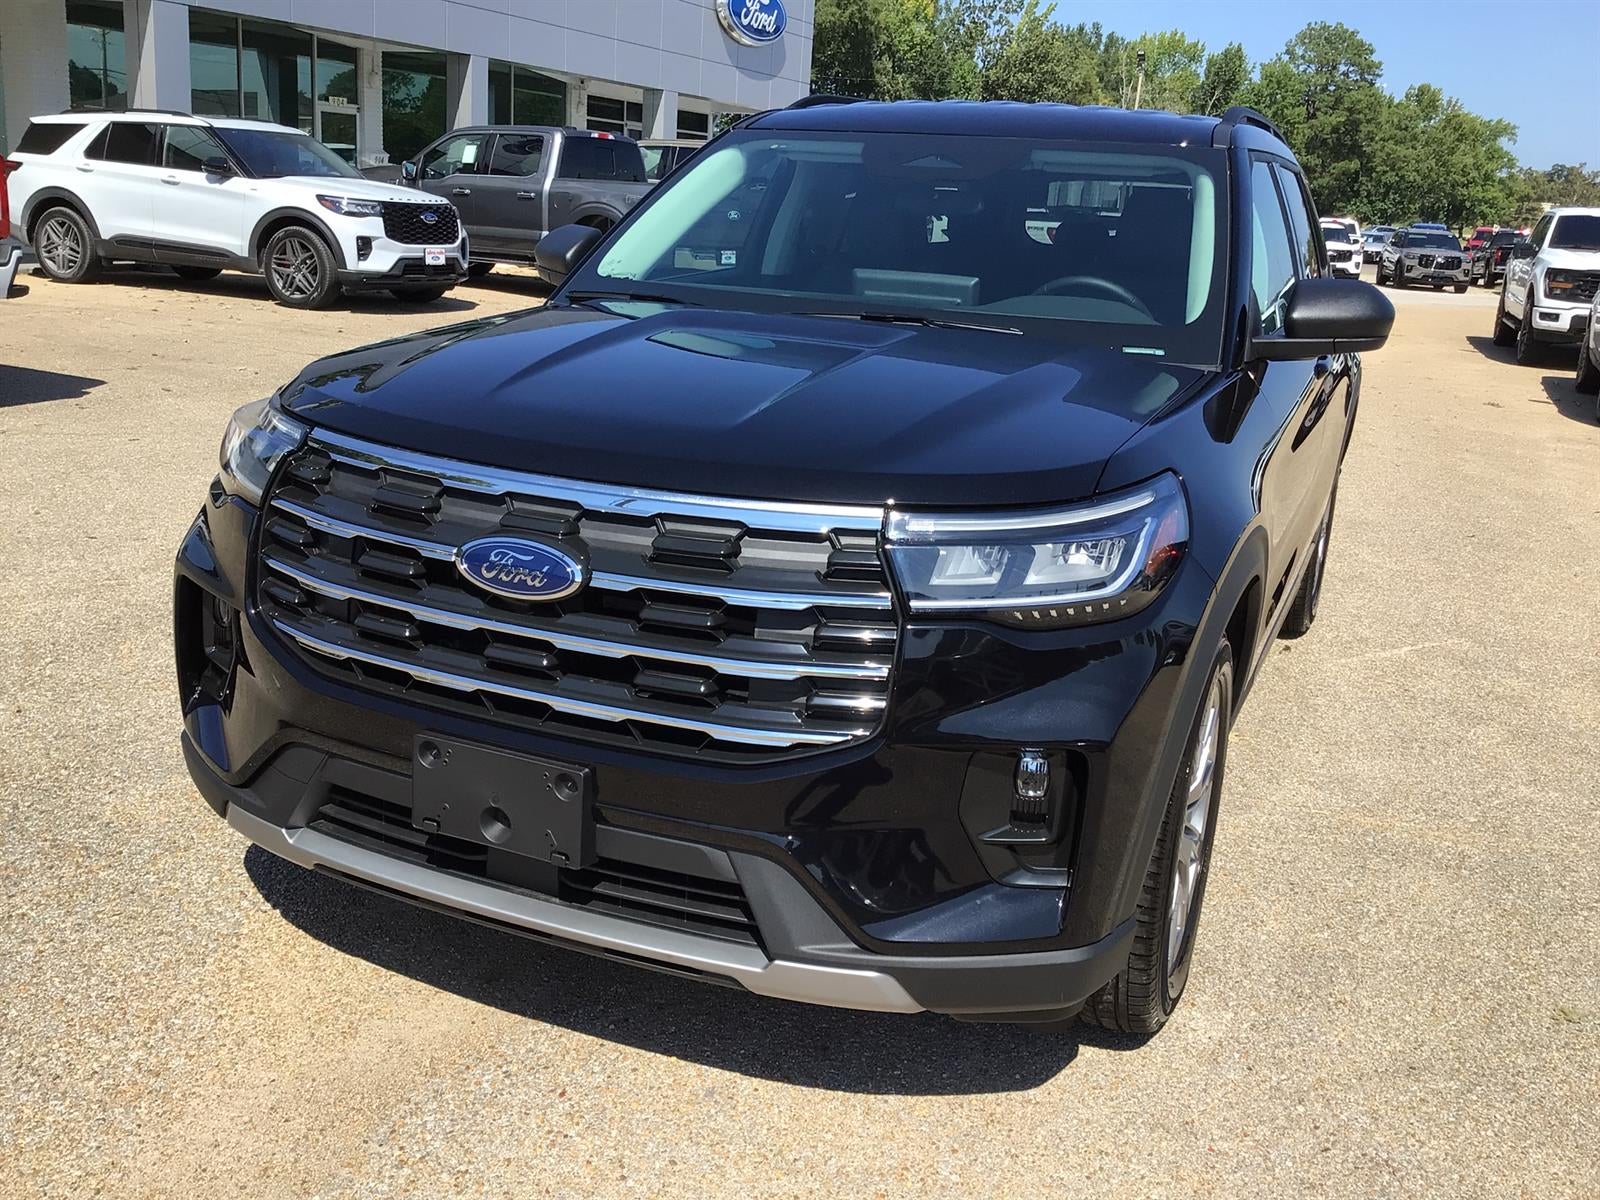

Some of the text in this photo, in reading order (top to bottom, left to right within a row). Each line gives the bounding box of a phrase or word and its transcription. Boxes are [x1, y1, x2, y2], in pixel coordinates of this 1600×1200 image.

[741, 0, 778, 33] Ford
[331, 97, 346, 107] 904
[481, 548, 551, 588] Ford
